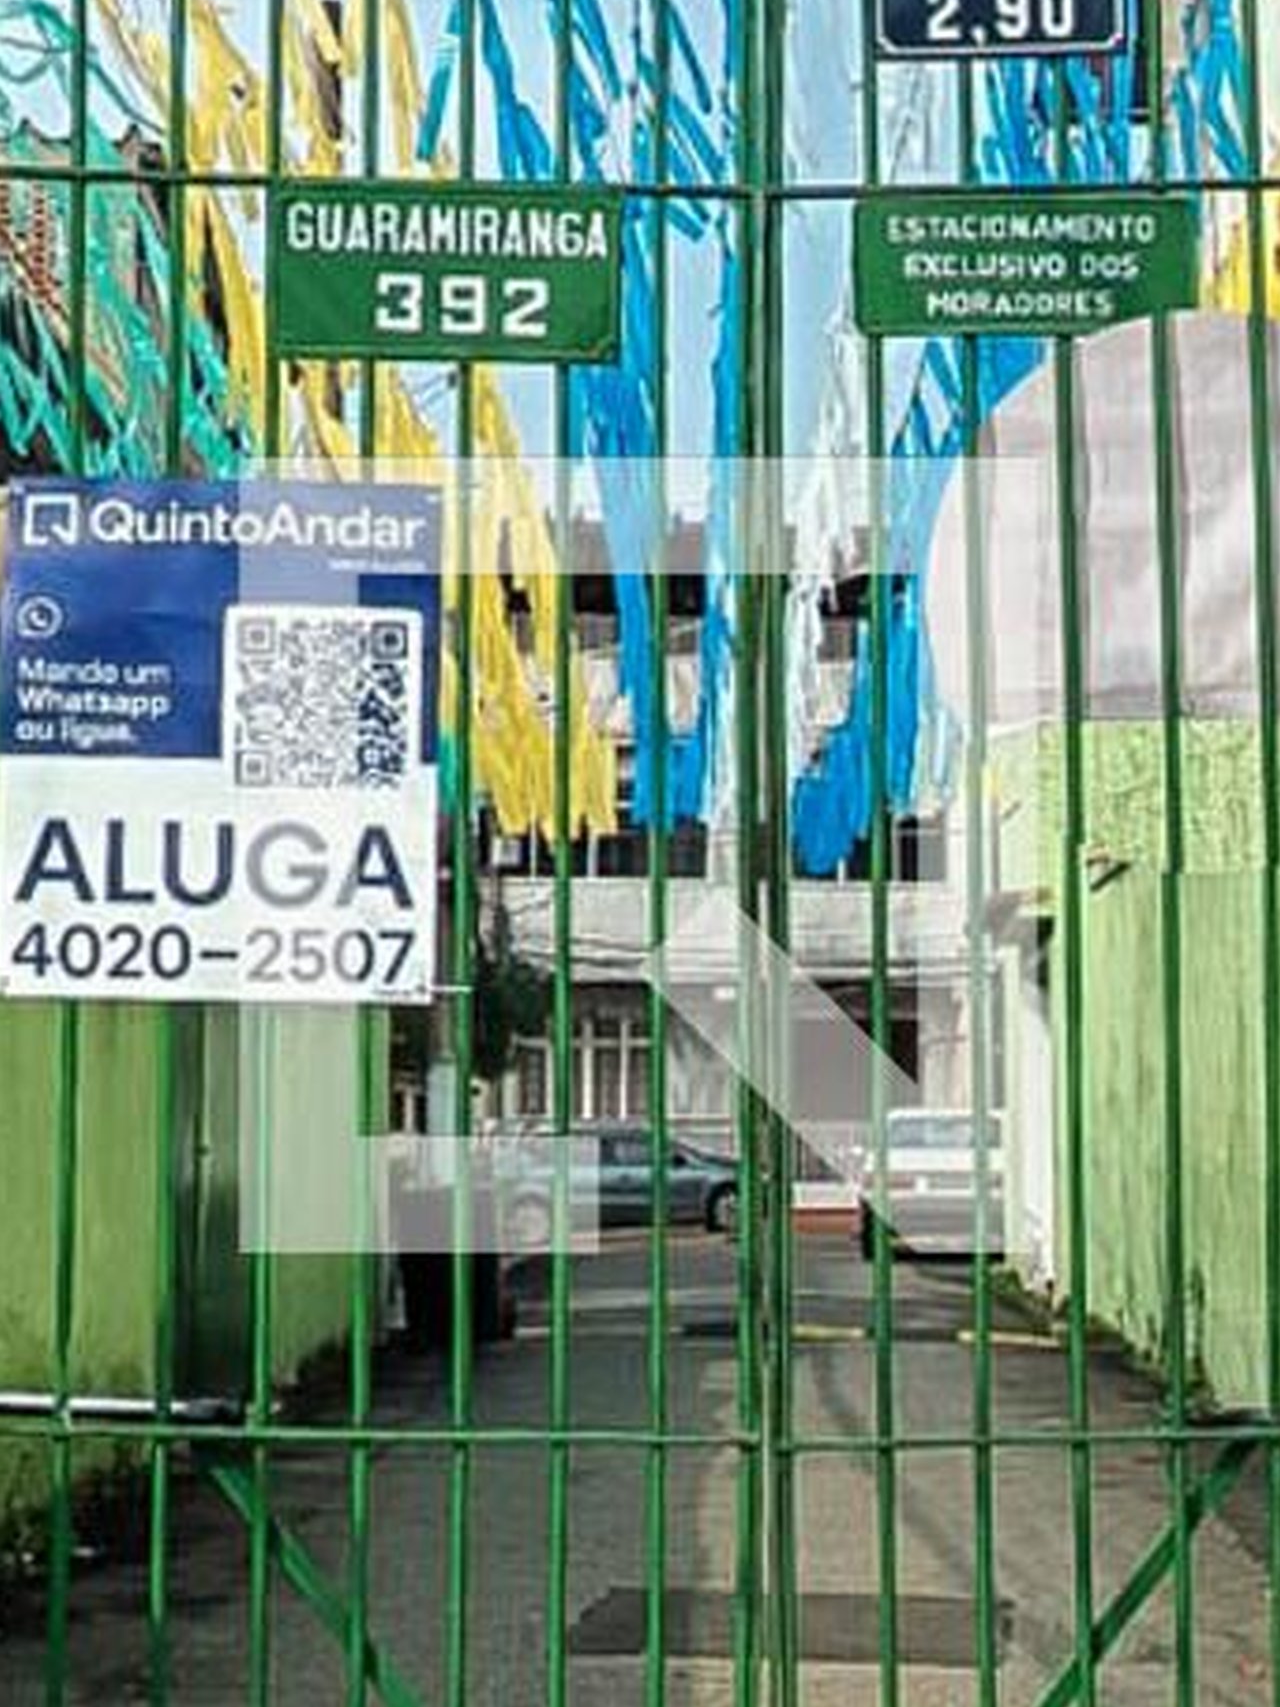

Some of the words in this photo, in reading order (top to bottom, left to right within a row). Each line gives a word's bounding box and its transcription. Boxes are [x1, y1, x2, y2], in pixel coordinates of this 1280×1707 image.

[286, 201, 608, 258] GUARAMIRANGA
[887, 214, 1156, 242] ESTACIONAMENTO
[904, 252, 1067, 279] EXCLUSIVO
[1080, 252, 1140, 281] DOS
[375, 273, 549, 336] 392
[927, 292, 1114, 317] MORADORES
[90, 499, 427, 550] QuintoAndar
[123, 664, 171, 685] um
[16, 720, 53, 741] ou
[14, 817, 416, 910] ALUGA
[12, 923, 416, 986] 4020-2507
